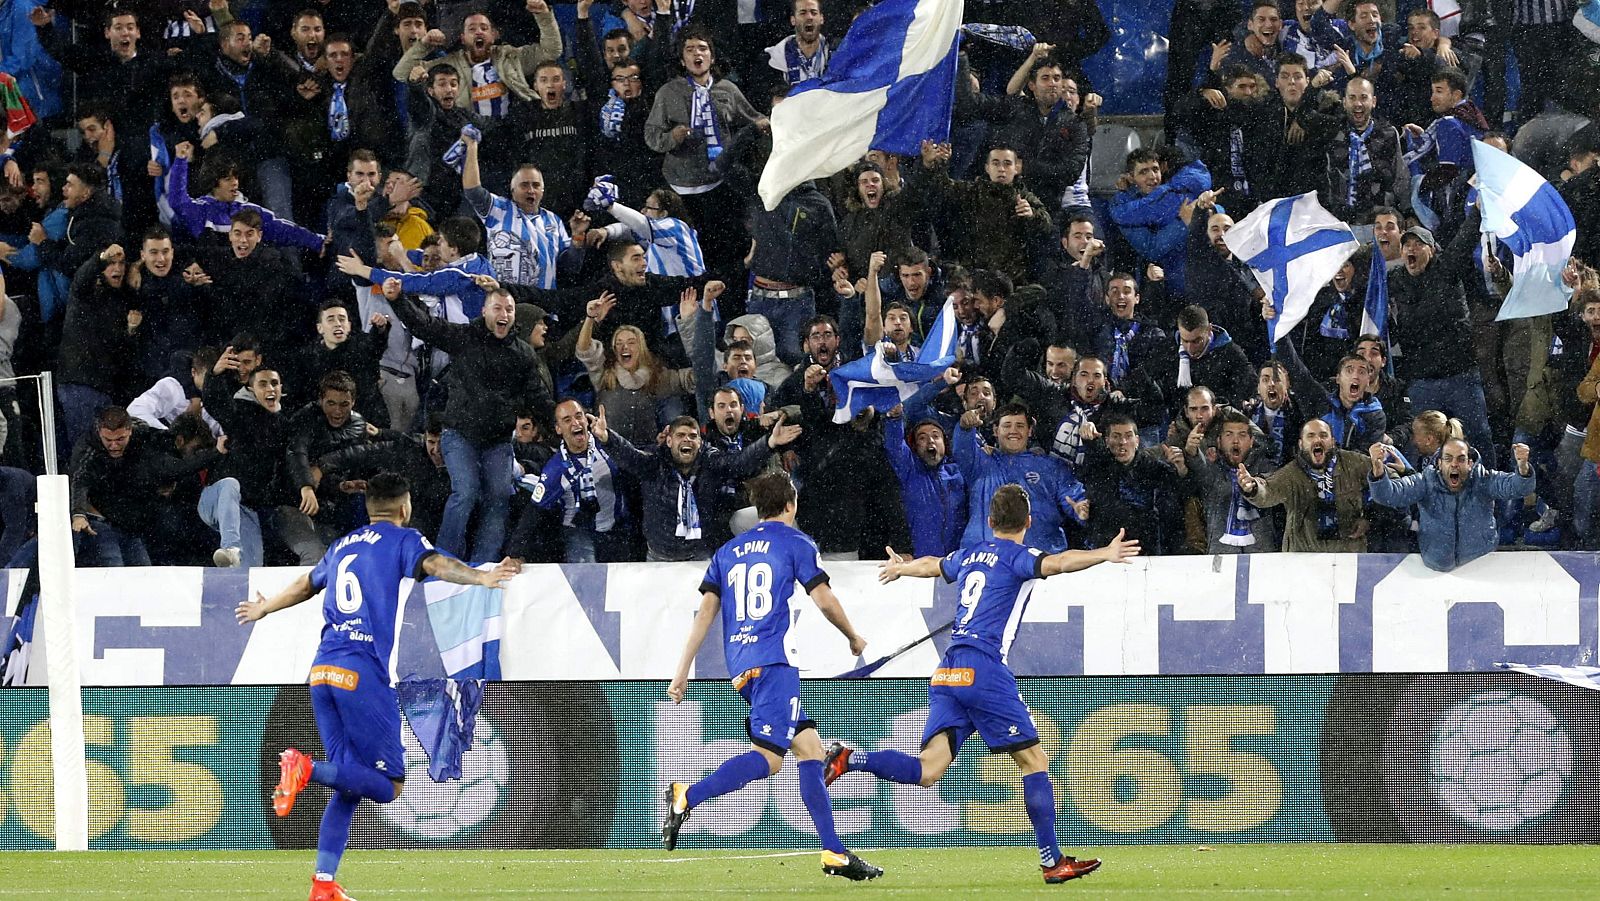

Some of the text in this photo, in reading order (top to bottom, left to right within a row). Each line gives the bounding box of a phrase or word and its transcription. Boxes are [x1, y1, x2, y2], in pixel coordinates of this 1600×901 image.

[732, 540, 770, 558] T.PINA
[335, 554, 363, 614] 6
[727, 562, 773, 621] 18
[960, 570, 986, 624] 9
[789, 696, 801, 721] 1
[0, 714, 224, 842] 65
[654, 701, 1285, 835] bet365
